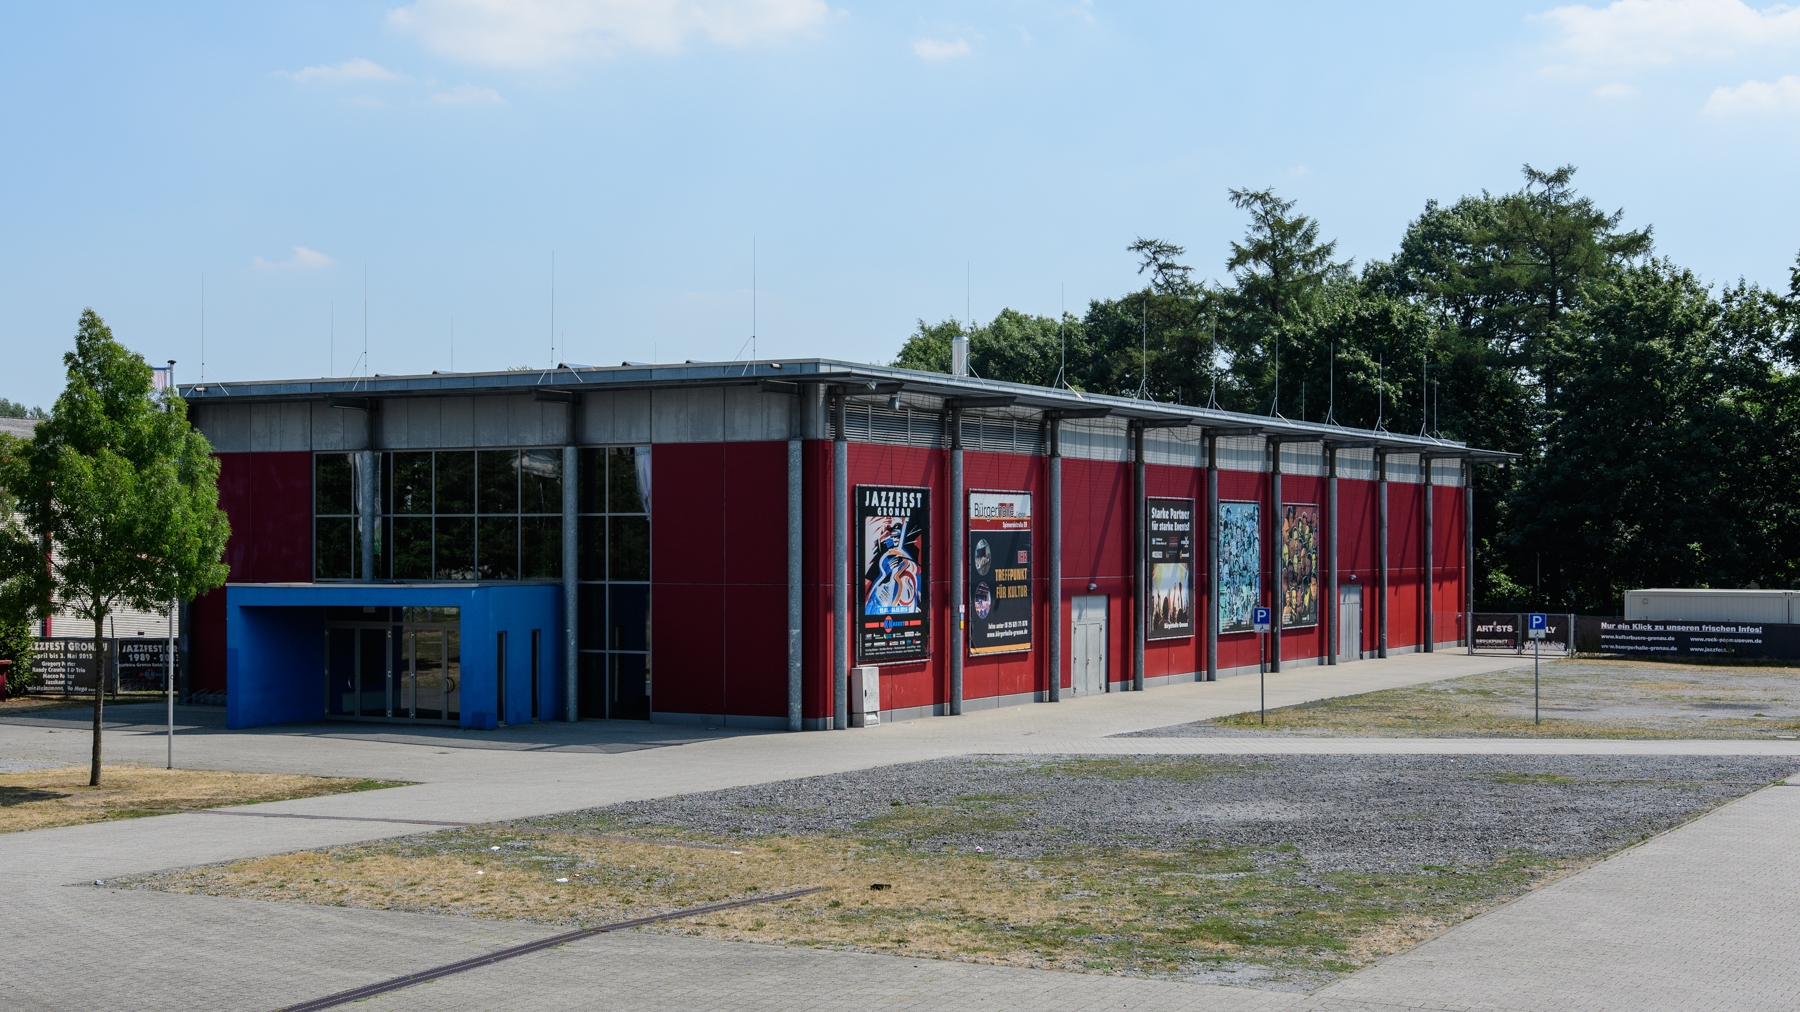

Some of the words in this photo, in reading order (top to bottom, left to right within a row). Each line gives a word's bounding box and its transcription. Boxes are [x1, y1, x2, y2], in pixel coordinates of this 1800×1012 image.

[865, 491, 922, 508] JAZZFEST
[877, 507, 911, 516] GRONAU
[974, 502, 1014, 522] Bürgerhalle
[1151, 507, 1169, 519] Starke
[1170, 508, 1190, 519] Partner
[1151, 521, 1159, 530] für
[1159, 521, 1174, 531] starke
[1174, 521, 1190, 531] Events!
[1017, 550, 1027, 563] IHR
[995, 568, 1028, 581] TREFFPUNKT
[996, 584, 1006, 598] FÜR
[1007, 585, 1028, 598] KULTUR
[1257, 609, 1267, 622] P
[1532, 615, 1542, 628] P
[1702, 624, 1736, 632] frischen
[28, 642, 66, 651] AZZFEST
[67, 642, 108, 652] GRONU
[122, 644, 163, 653] JAZZFEST
[128, 653, 150, 661] 1989
